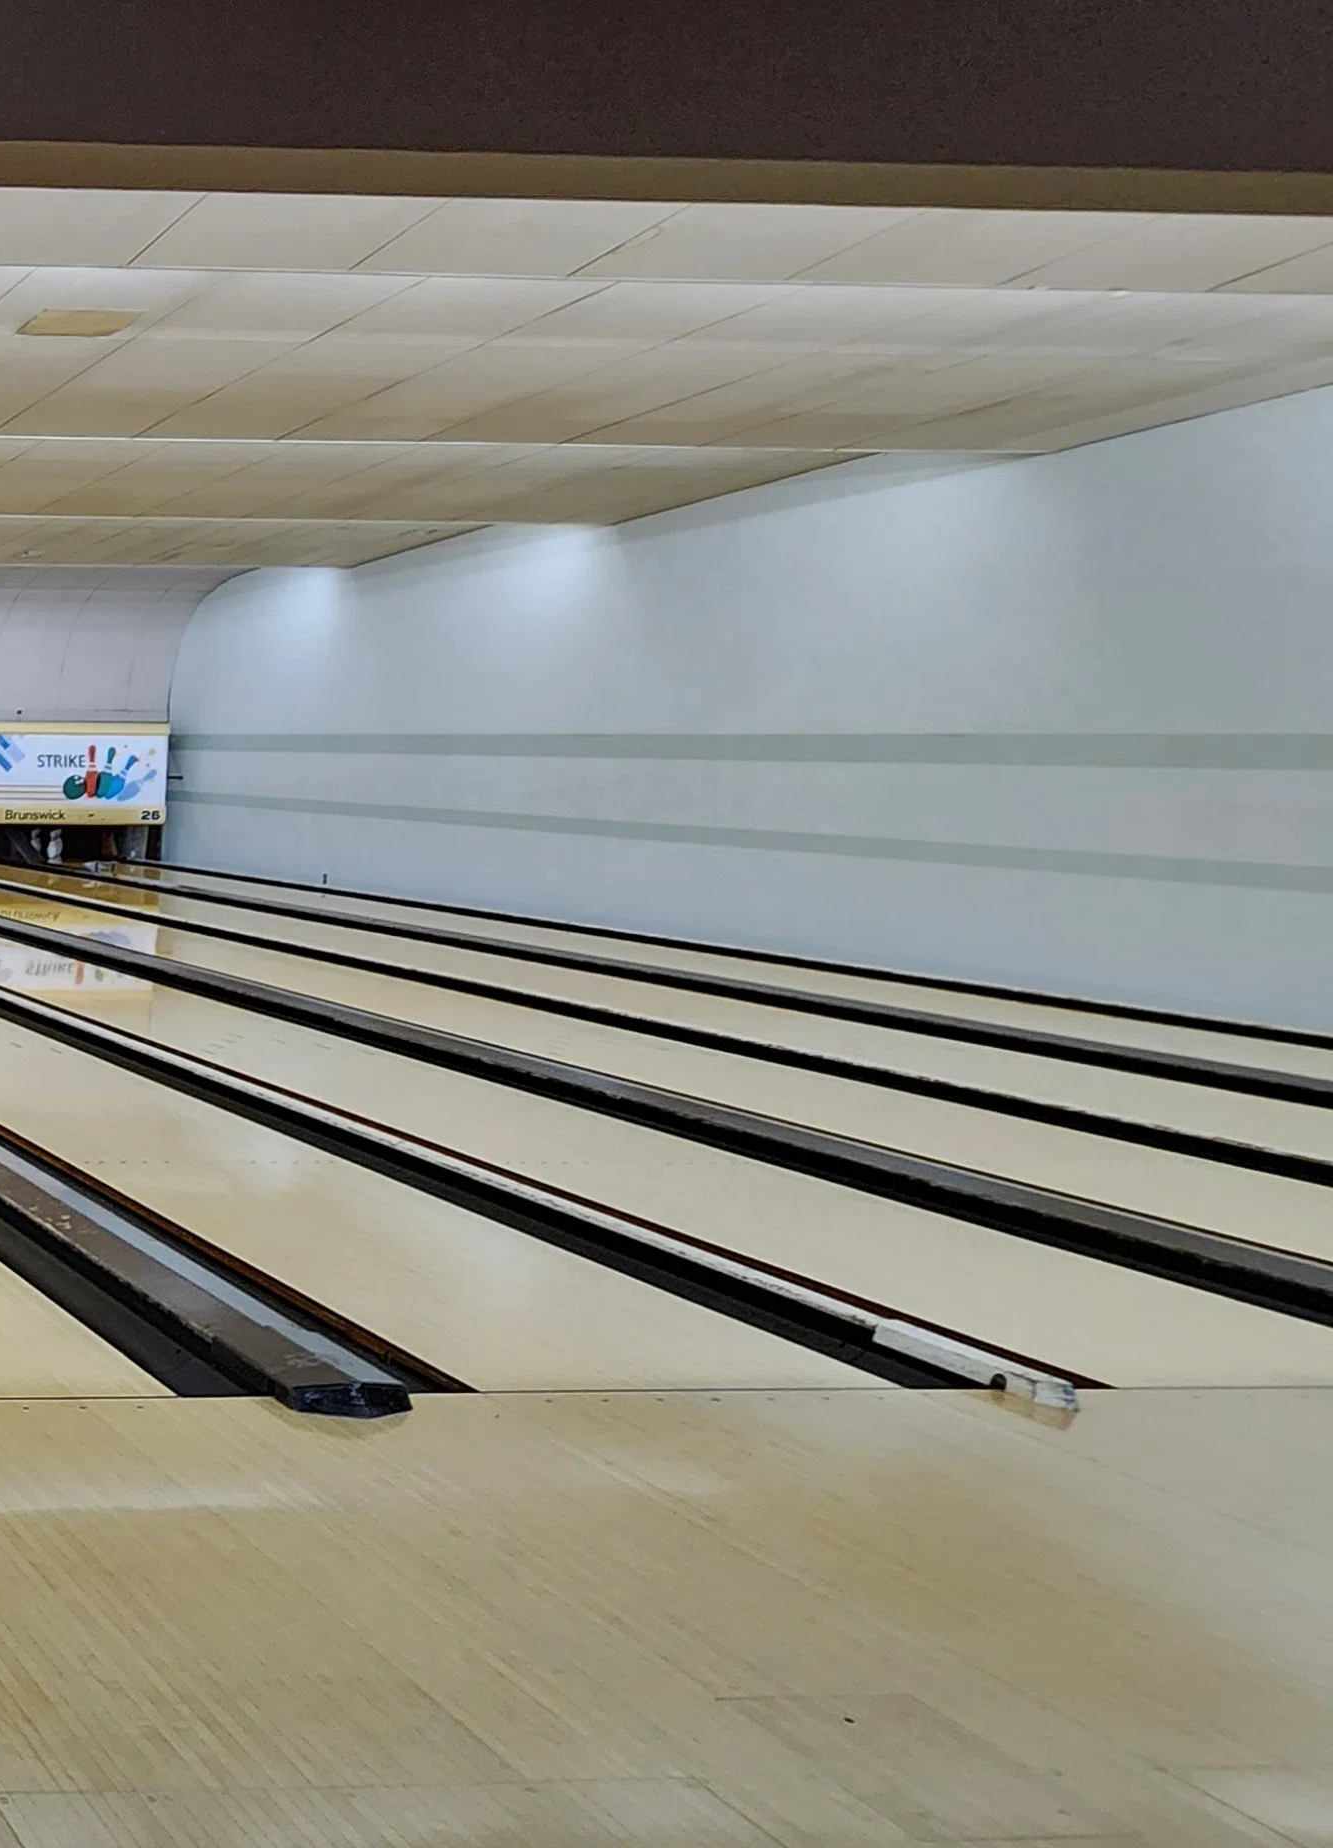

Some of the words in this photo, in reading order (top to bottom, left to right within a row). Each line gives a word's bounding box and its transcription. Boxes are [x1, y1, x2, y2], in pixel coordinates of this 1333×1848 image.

[37, 754, 86, 769] STRIKE
[4, 809, 66, 821] Brunswick
[140, 810, 161, 821] 26
